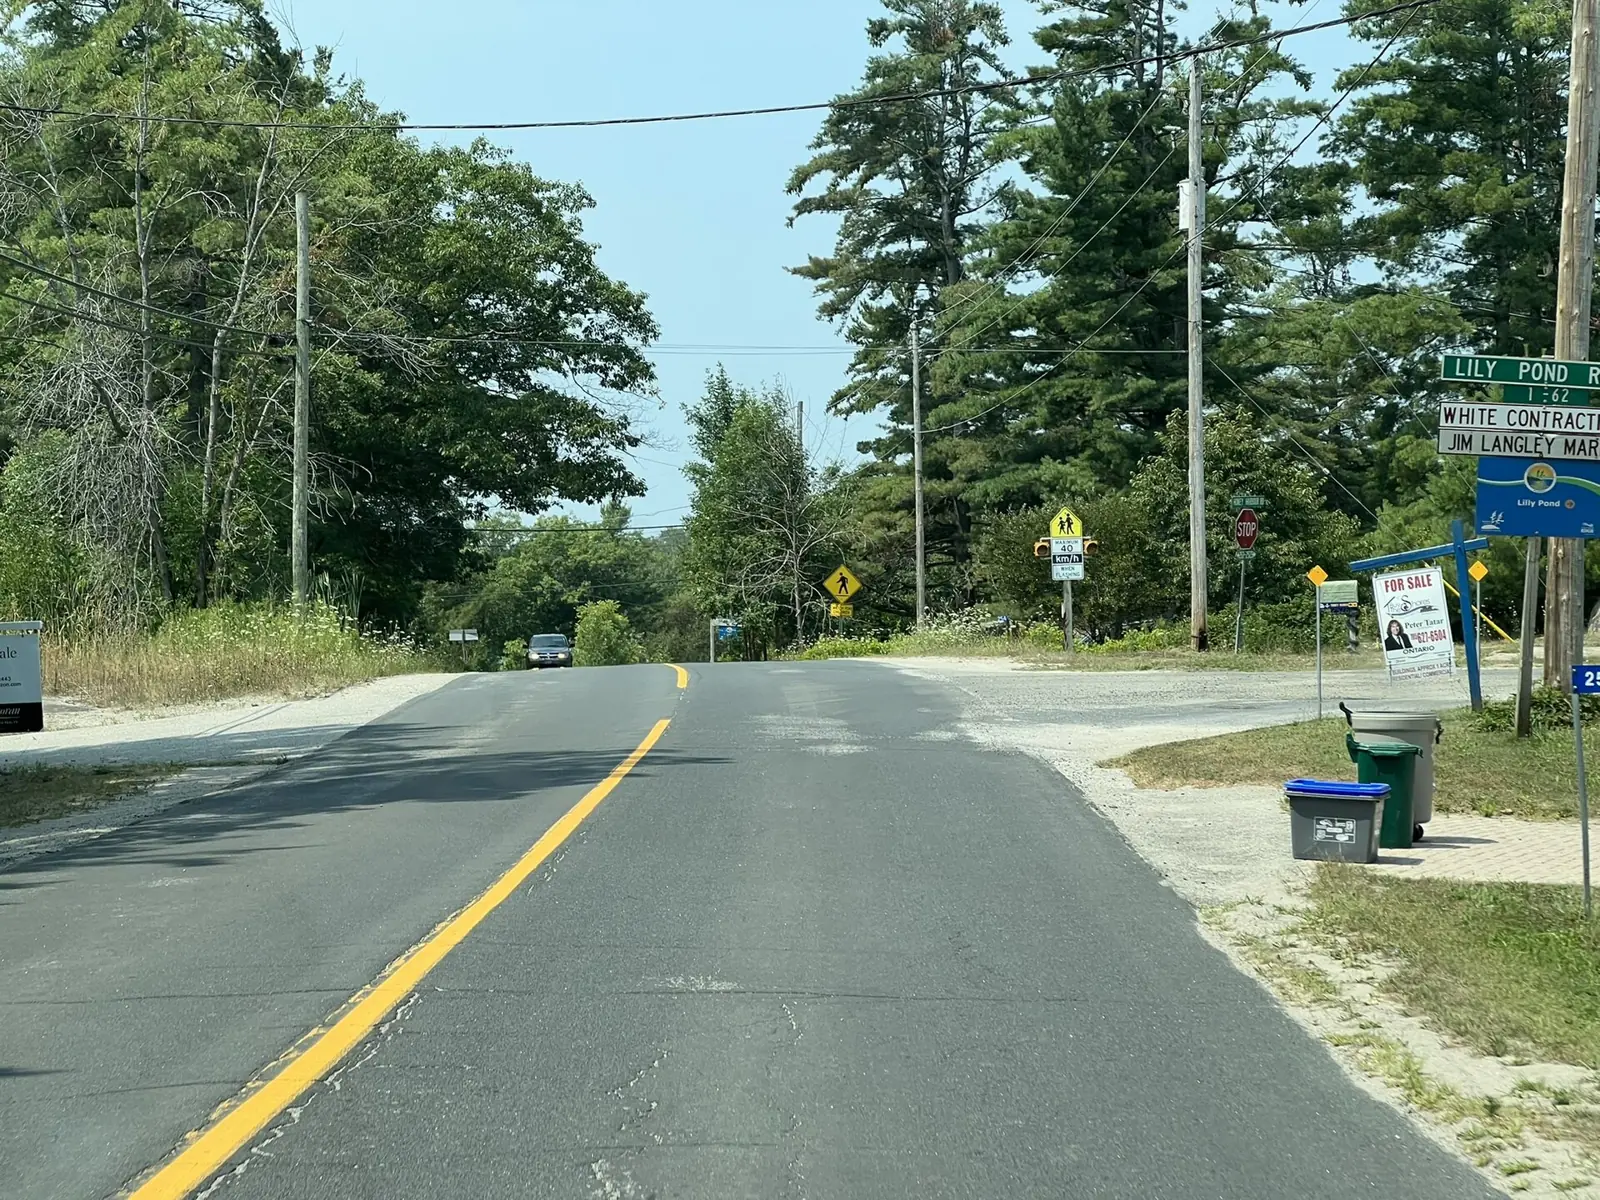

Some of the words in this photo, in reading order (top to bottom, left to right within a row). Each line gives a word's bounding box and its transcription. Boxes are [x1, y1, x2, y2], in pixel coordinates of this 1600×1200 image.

[1455, 358, 1497, 378] LILY
[1519, 361, 1568, 383] POND
[1444, 406, 1497, 426] WHITE
[1507, 409, 1600, 431] CONTRACT
[1448, 433, 1473, 451] JIM
[1481, 434, 1555, 454] LANGLEY
[1517, 499, 1535, 508] Lilly
[1237, 522, 1256, 537] STOP
[1055, 554, 1080, 563] km/h
[1384, 578, 1405, 593] FOR
[1407, 574, 1433, 590] SALE
[1402, 645, 1435, 654] ONTARIO
